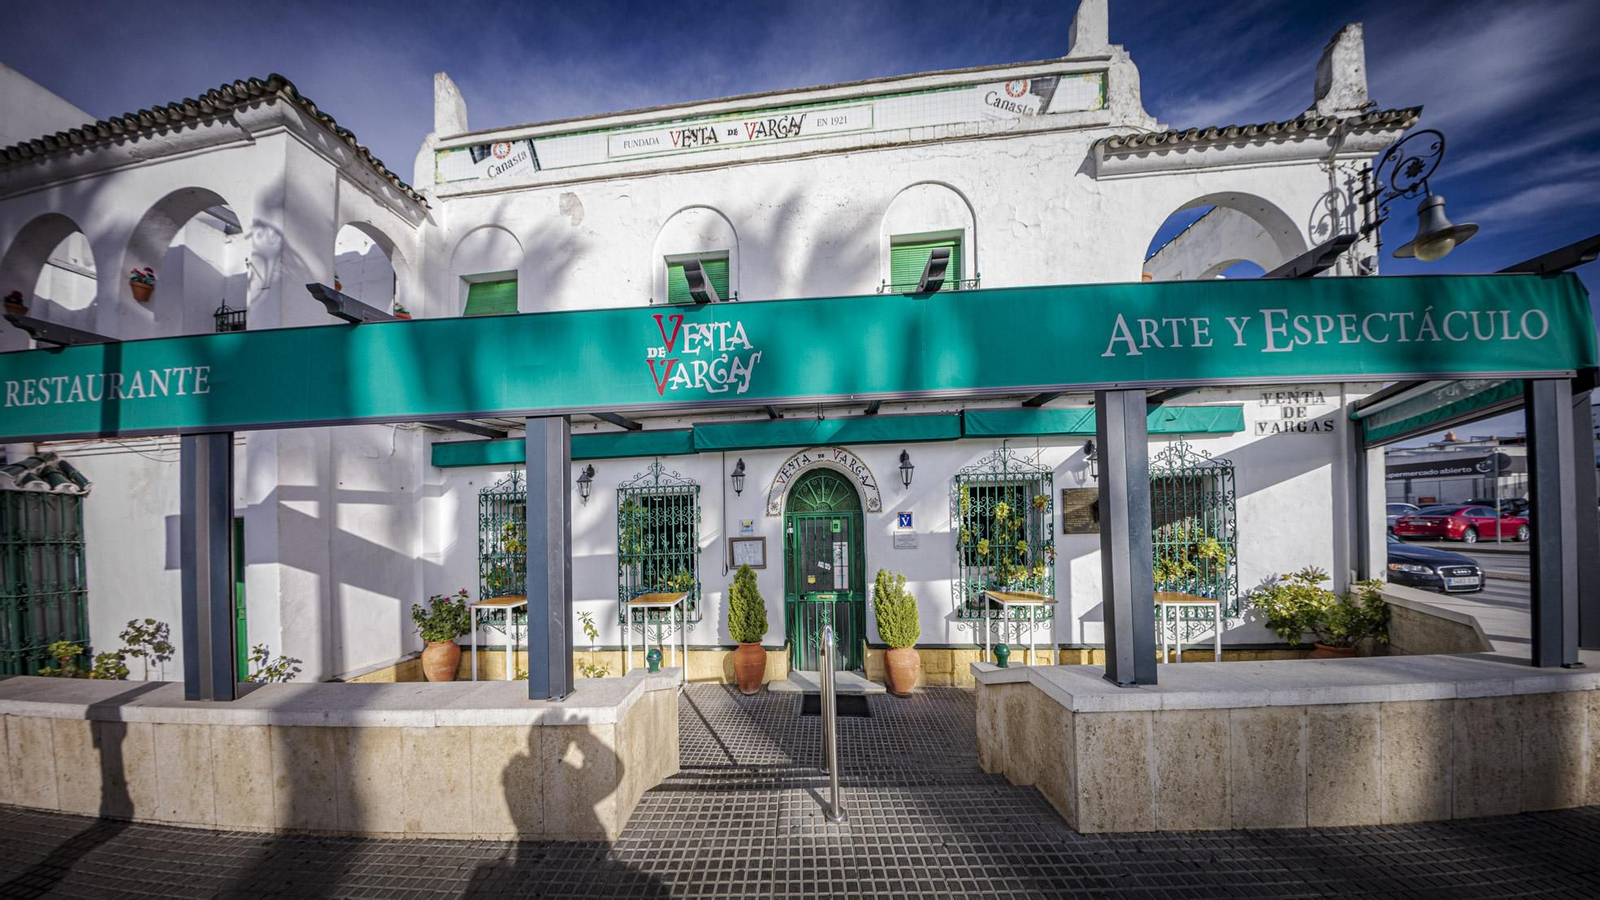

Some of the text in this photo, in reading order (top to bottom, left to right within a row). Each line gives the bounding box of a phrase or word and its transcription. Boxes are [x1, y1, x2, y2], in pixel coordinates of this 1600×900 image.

[984, 90, 1034, 116] Canasta
[623, 113, 847, 149] FUNDADA VENTA DE VARGAS EN 1921
[487, 150, 528, 178] Canasta
[652, 314, 753, 356] VENTA
[1101, 305, 1549, 357] ARTE Y ESPECTÁCULO
[646, 346, 667, 358] DE
[4, 365, 211, 407] RESTAURANTE
[646, 351, 762, 397] VARGAS
[1262, 391, 1325, 405] VENTA
[1283, 406, 1307, 419] DE
[1258, 420, 1334, 434] VARGAS
[776, 453, 812, 485] VENTA
[833, 449, 876, 490] VARGAS
[1385, 467, 1472, 479] upermercado abierto
